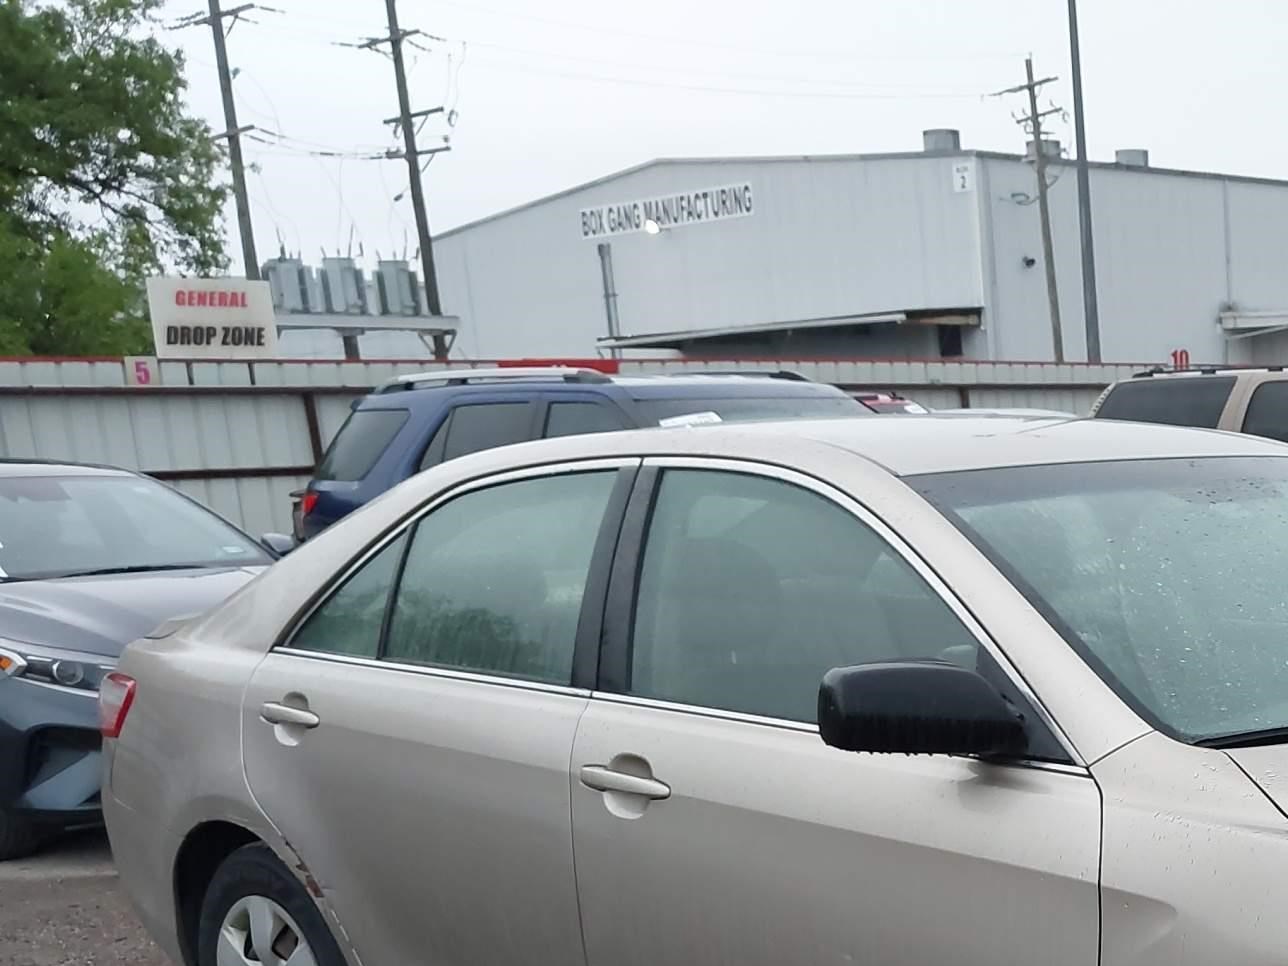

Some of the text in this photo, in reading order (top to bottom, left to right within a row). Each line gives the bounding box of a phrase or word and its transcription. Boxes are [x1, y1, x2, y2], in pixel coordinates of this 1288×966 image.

[581, 184, 752, 237] BOX GANG MANUFACTURING
[175, 290, 248, 307] GENERAL
[166, 325, 265, 346] DROP ZONE
[1171, 349, 1189, 370] 10
[134, 361, 150, 385] 5
